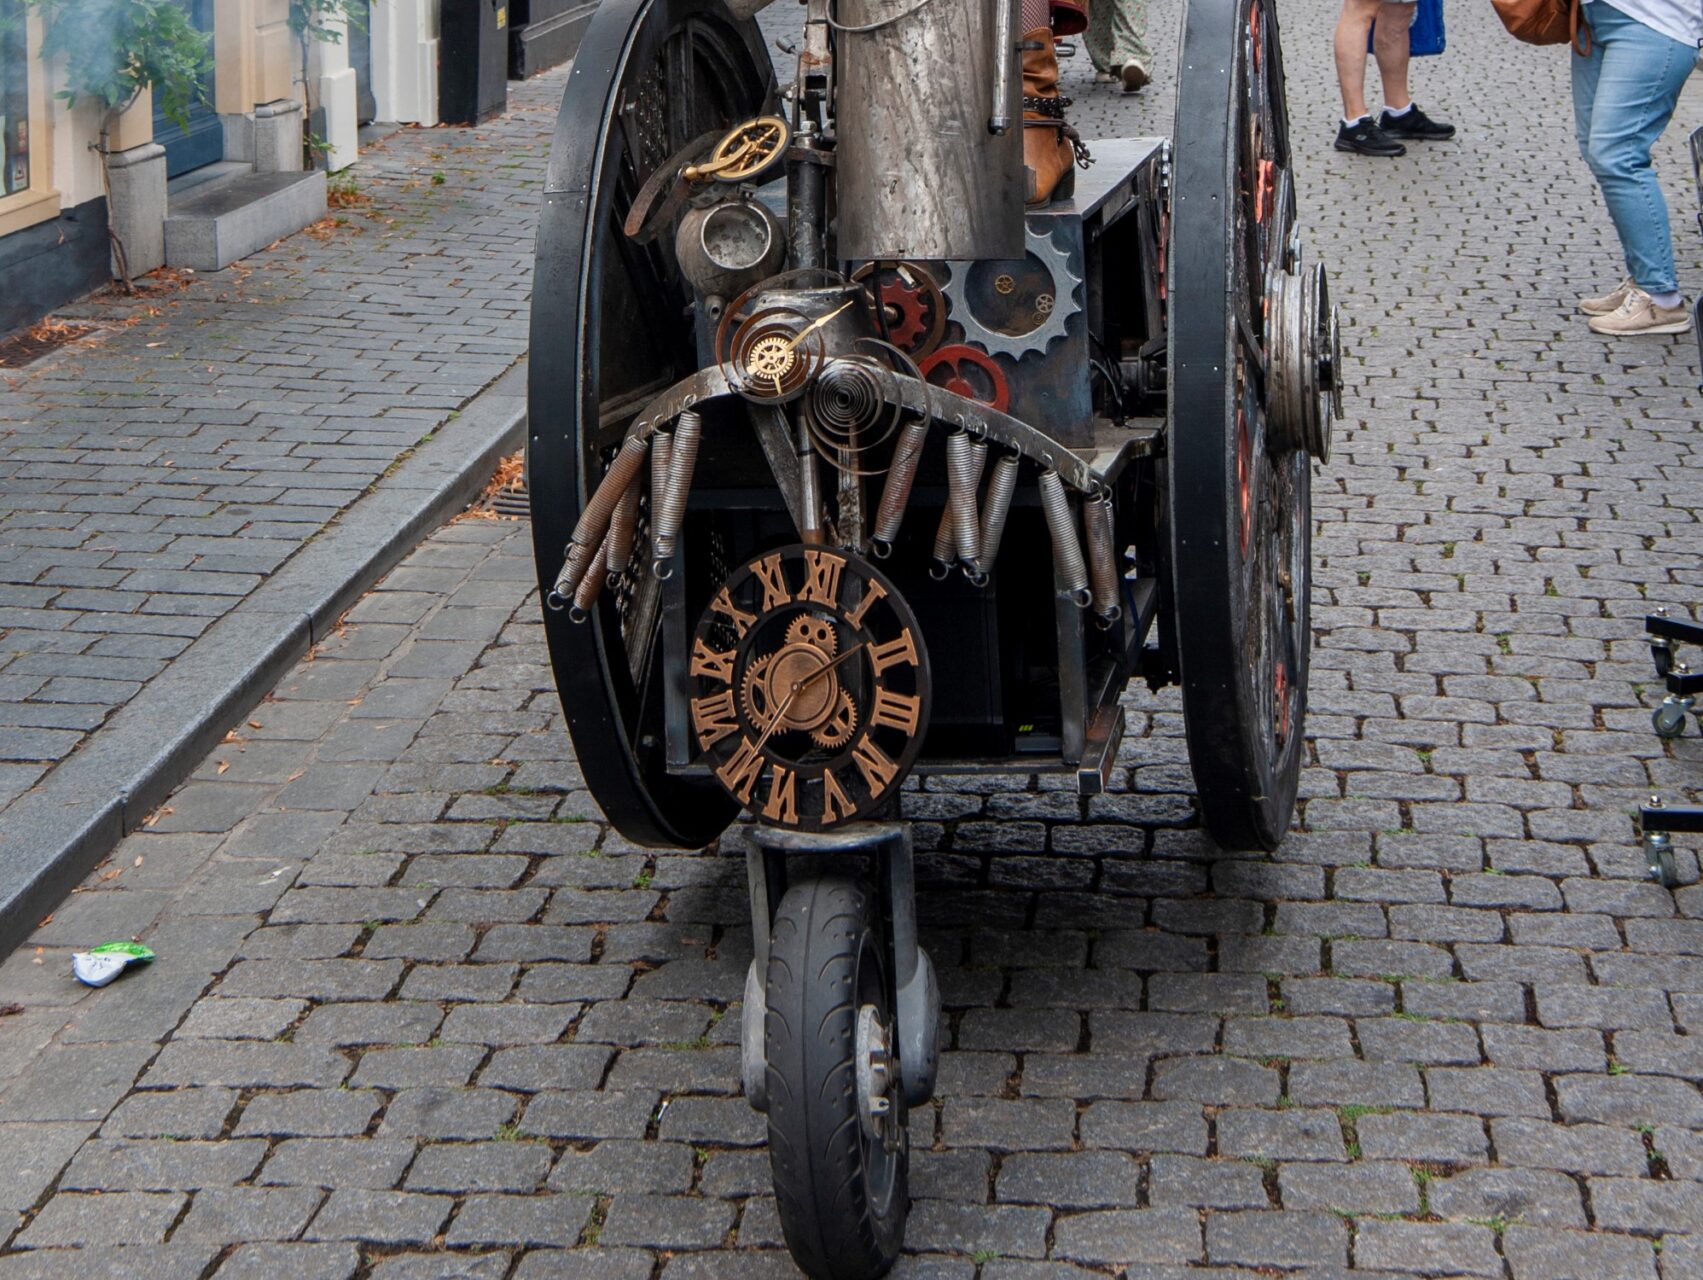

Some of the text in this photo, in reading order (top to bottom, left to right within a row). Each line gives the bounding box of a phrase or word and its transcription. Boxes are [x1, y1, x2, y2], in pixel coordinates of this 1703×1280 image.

[749, 553, 791, 612] XI
[797, 550, 847, 609] XII
[844, 578, 888, 631] I
[710, 587, 757, 639] X
[690, 639, 736, 683] IX
[867, 628, 918, 677] II
[691, 690, 739, 752] VIII
[870, 686, 920, 738] III
[716, 736, 764, 804] VII
[762, 764, 799, 825] VI
[852, 733, 899, 799] IV
[821, 768, 857, 824] V
